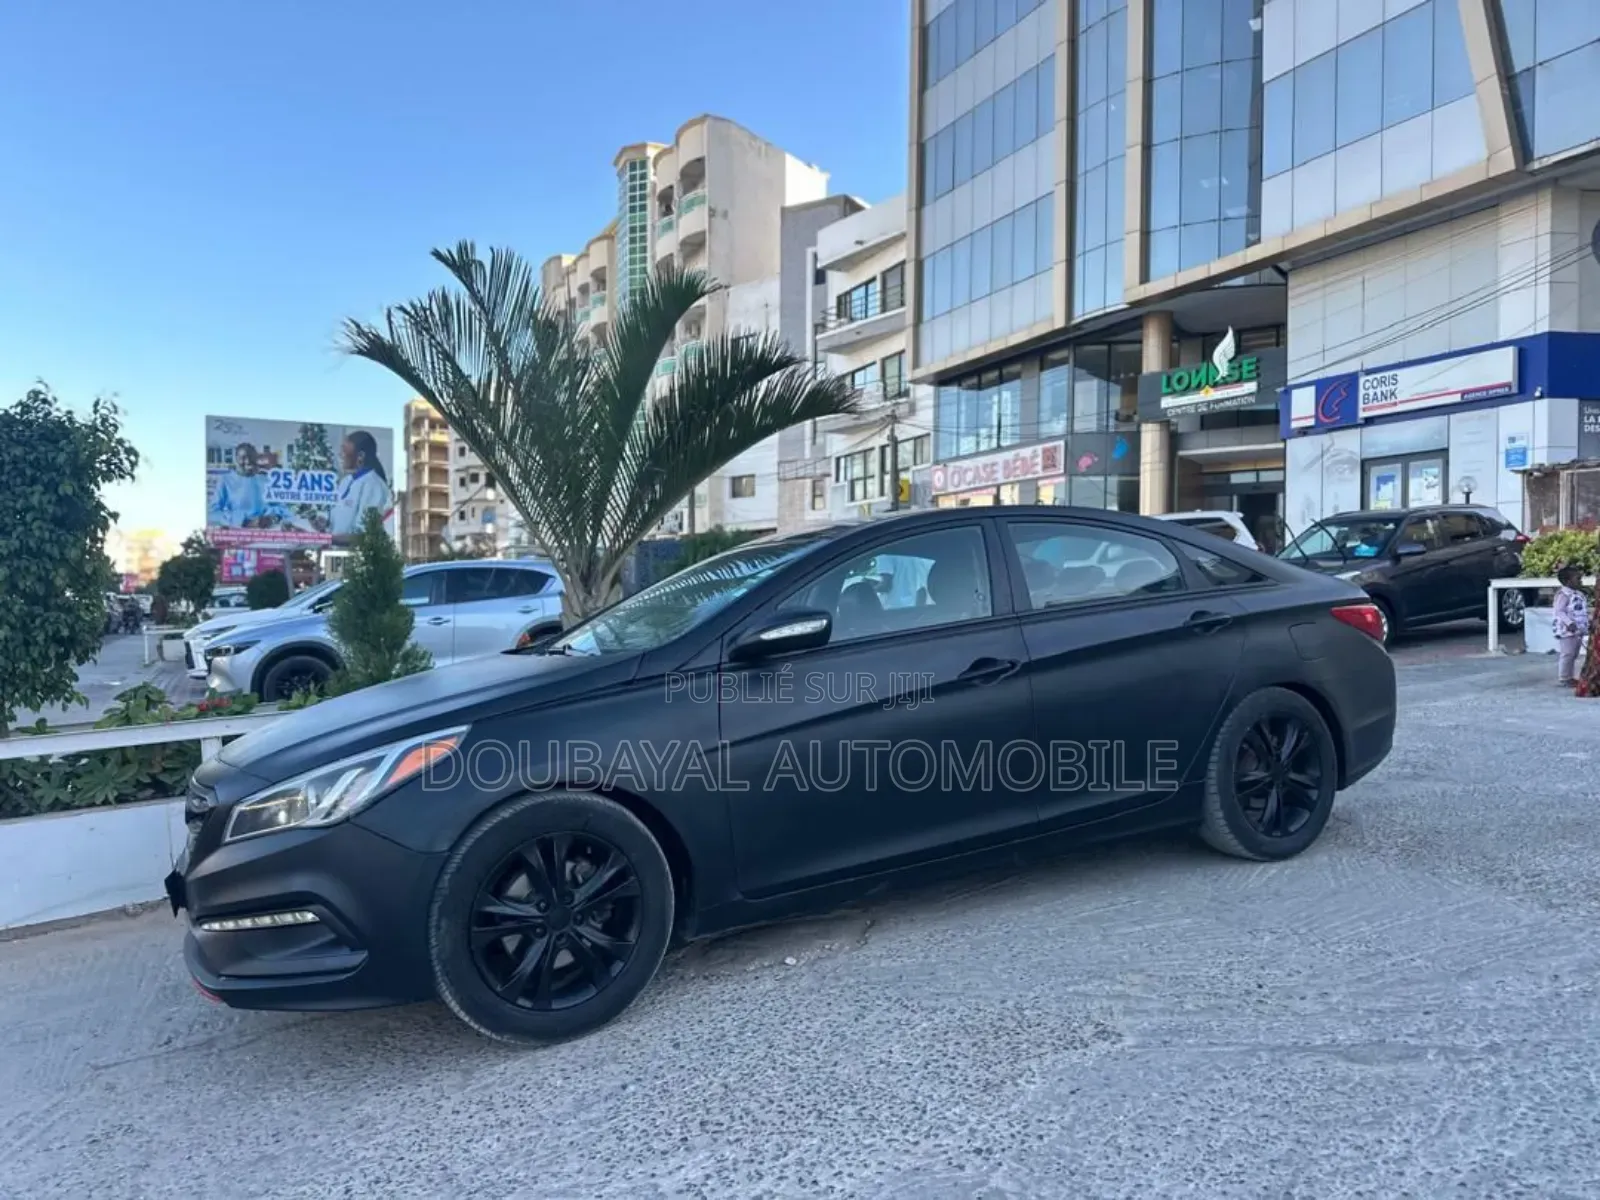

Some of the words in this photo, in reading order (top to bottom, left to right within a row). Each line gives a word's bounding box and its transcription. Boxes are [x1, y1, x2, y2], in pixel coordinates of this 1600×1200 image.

[1362, 373, 1398, 391] CORIS
[1362, 387, 1398, 405] BANK
[1197, 402, 1208, 412] DE
[271, 470, 293, 489] 25
[298, 472, 334, 493] ANS
[273, 491, 300, 501] VOTRE
[304, 493, 339, 502] SERVICE
